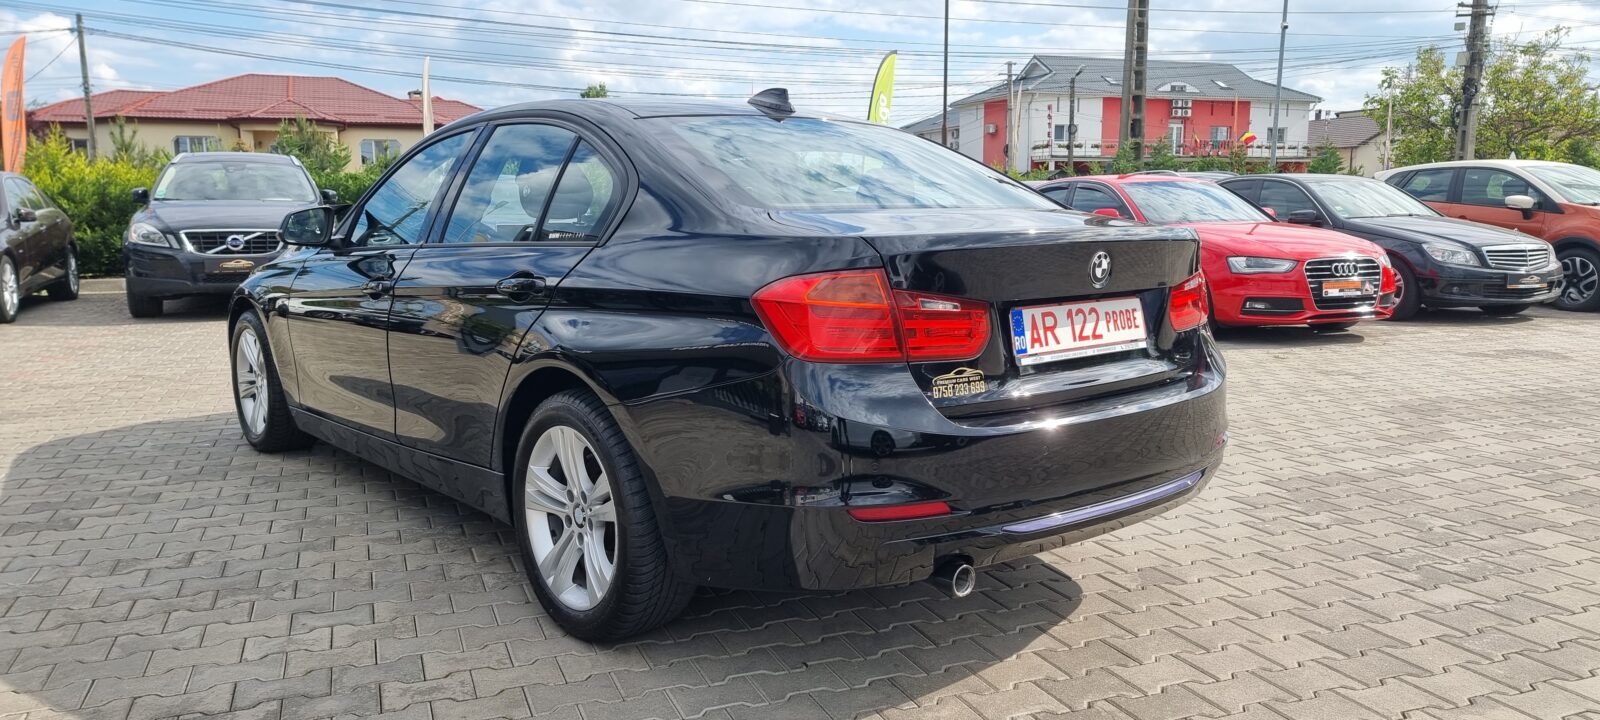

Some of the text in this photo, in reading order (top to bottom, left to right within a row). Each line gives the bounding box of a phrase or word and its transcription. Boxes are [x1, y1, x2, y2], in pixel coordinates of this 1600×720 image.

[1030, 307, 1139, 349] AR 122 PROBE
[1015, 336, 1026, 350] RO
[955, 383, 969, 396] 233
